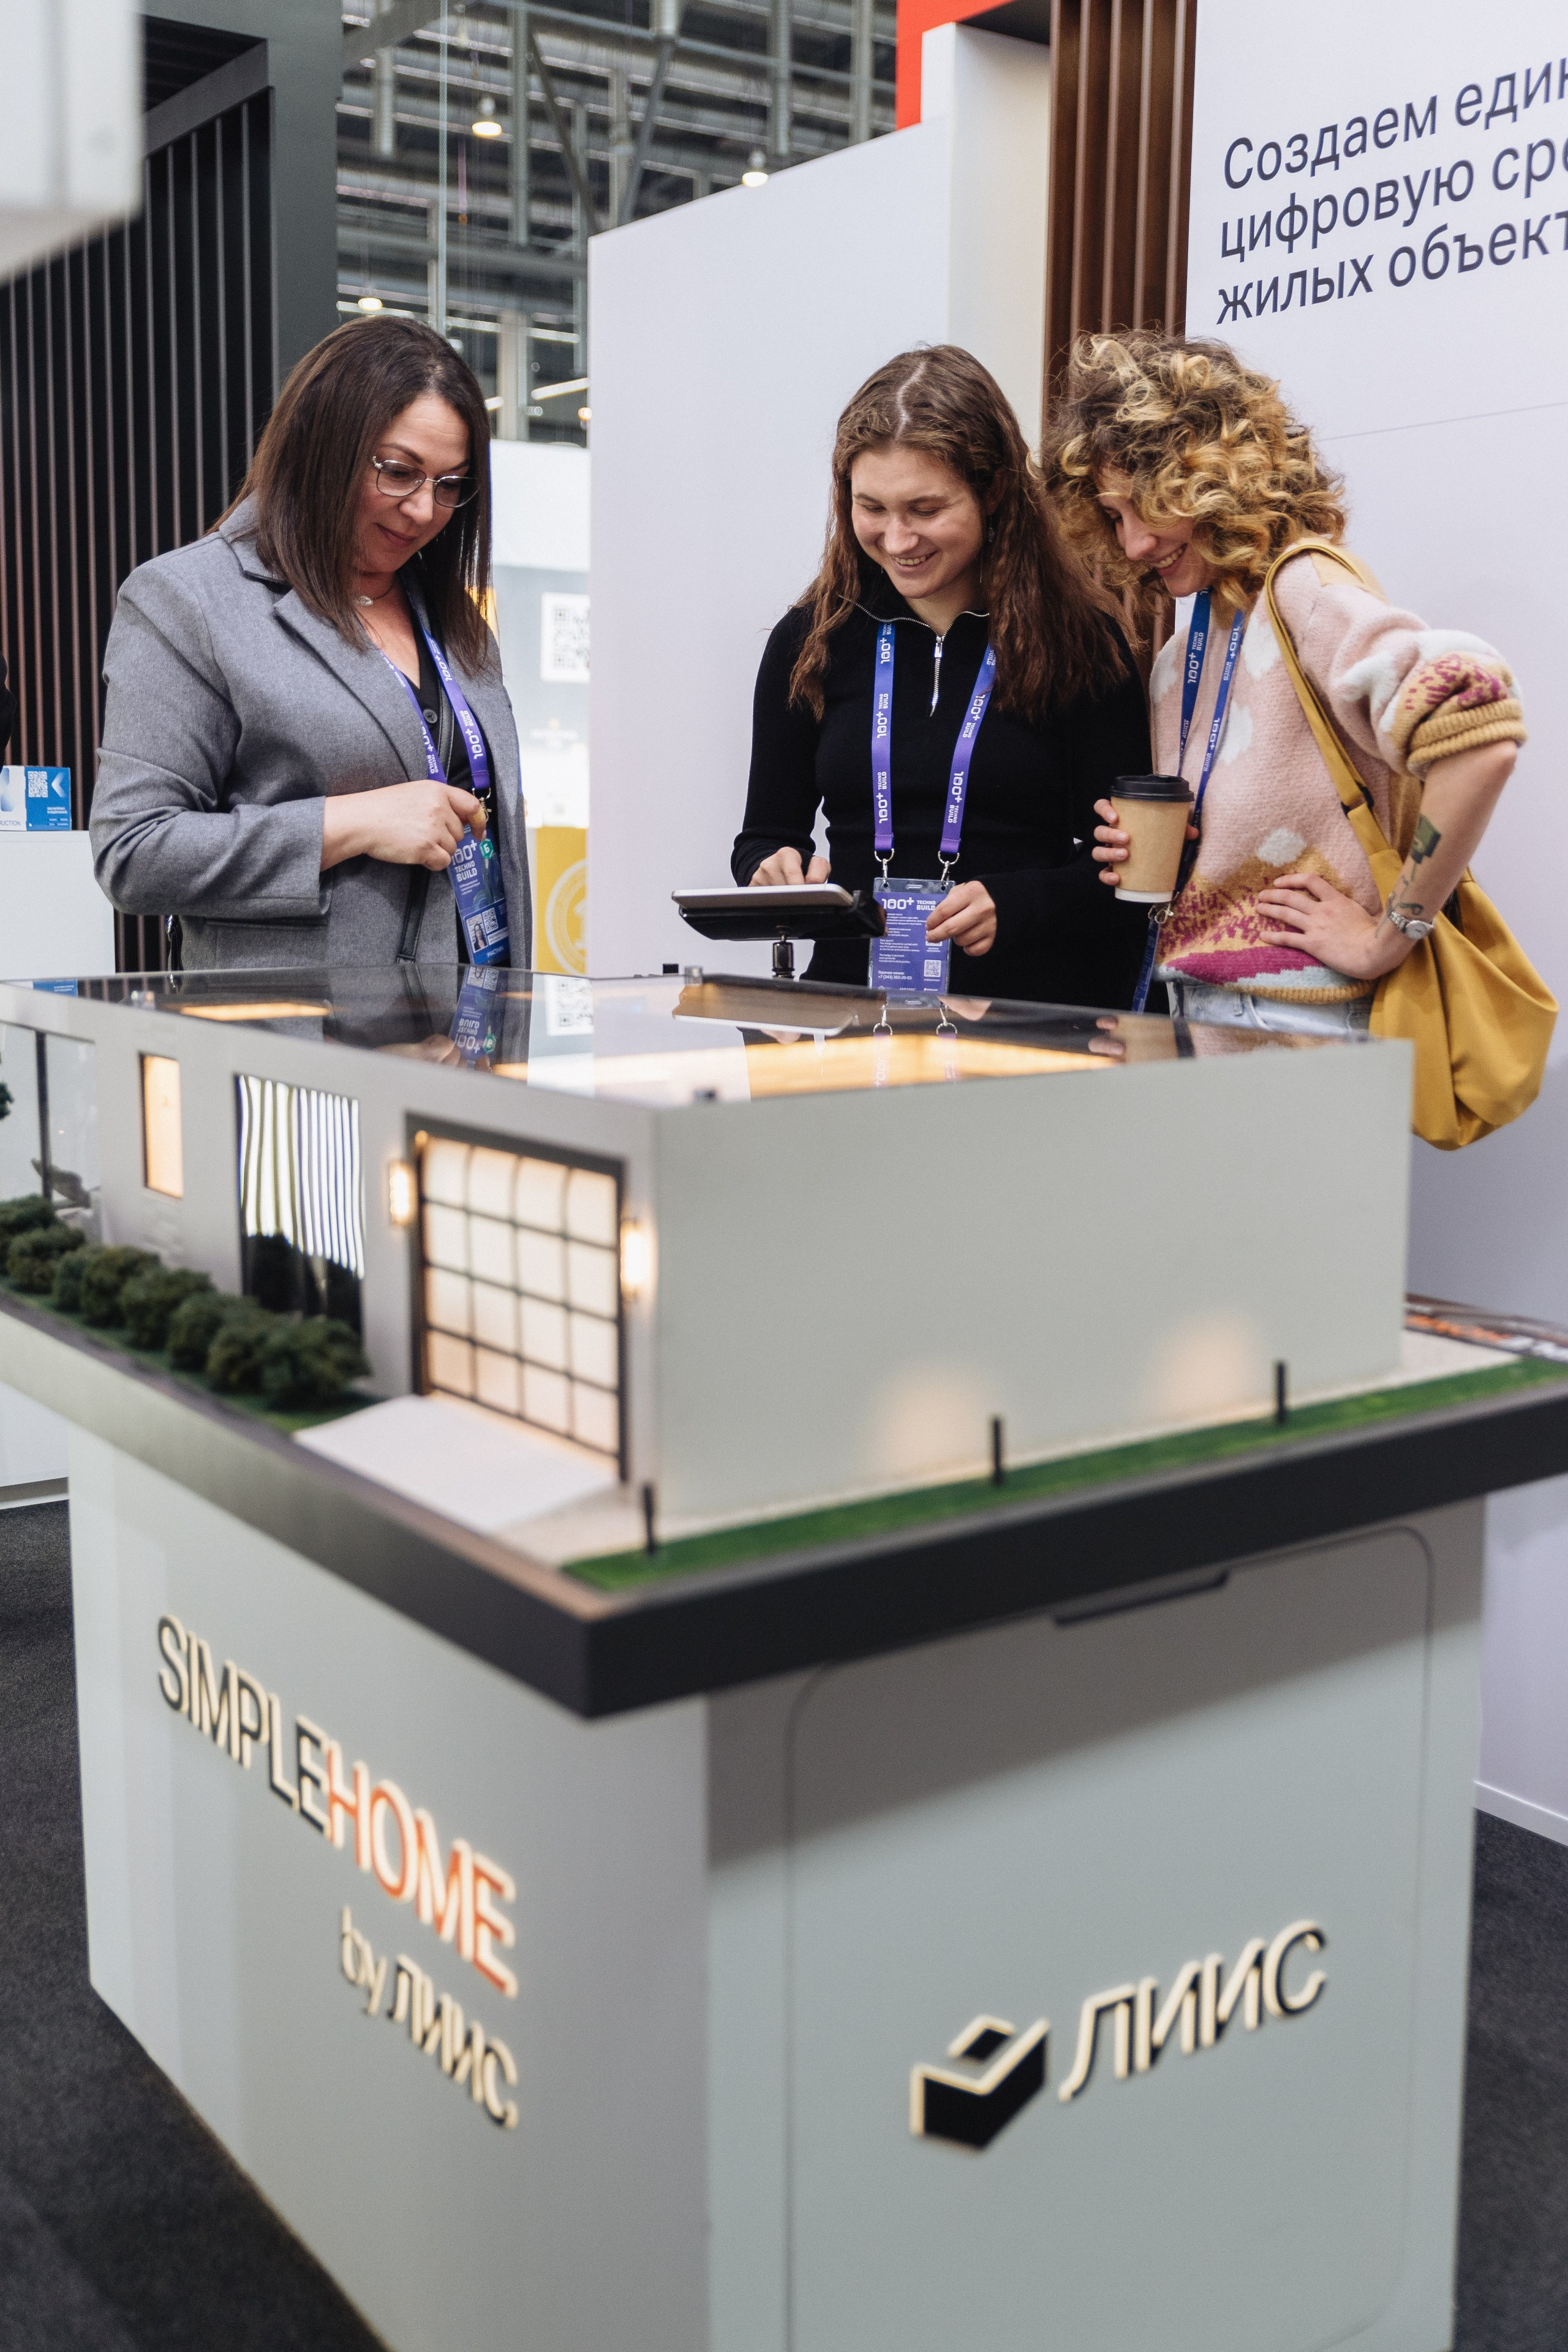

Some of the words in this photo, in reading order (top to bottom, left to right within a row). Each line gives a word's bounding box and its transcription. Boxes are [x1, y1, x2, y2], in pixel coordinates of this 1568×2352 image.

[1224, 95, 1438, 189] Создаем
[1221, 159, 1475, 263] цифровую
[1491, 137, 1568, 199] ср
[1216, 254, 1374, 325] жилых
[880, 637, 891, 664] 100+
[1229, 626, 1240, 659] 100+
[1188, 652, 1199, 684] 100+
[464, 710, 474, 727] BUILD
[971, 694, 986, 721] 100+
[876, 711, 888, 739] 100+
[962, 722, 972, 738] BUILD
[1210, 717, 1220, 750] 100+
[465, 728, 484, 760] 100+
[426, 755, 435, 774] BUILD
[951, 771, 964, 803] 100+
[876, 792, 888, 824] 100+
[454, 860, 475, 873] TECHNO
[456, 867, 478, 882] BUILD
[881, 897, 914, 910] 100+
[157, 1613, 519, 1999] SIMPLEHOME
[1058, 1918, 1327, 2103] ЛИИС
